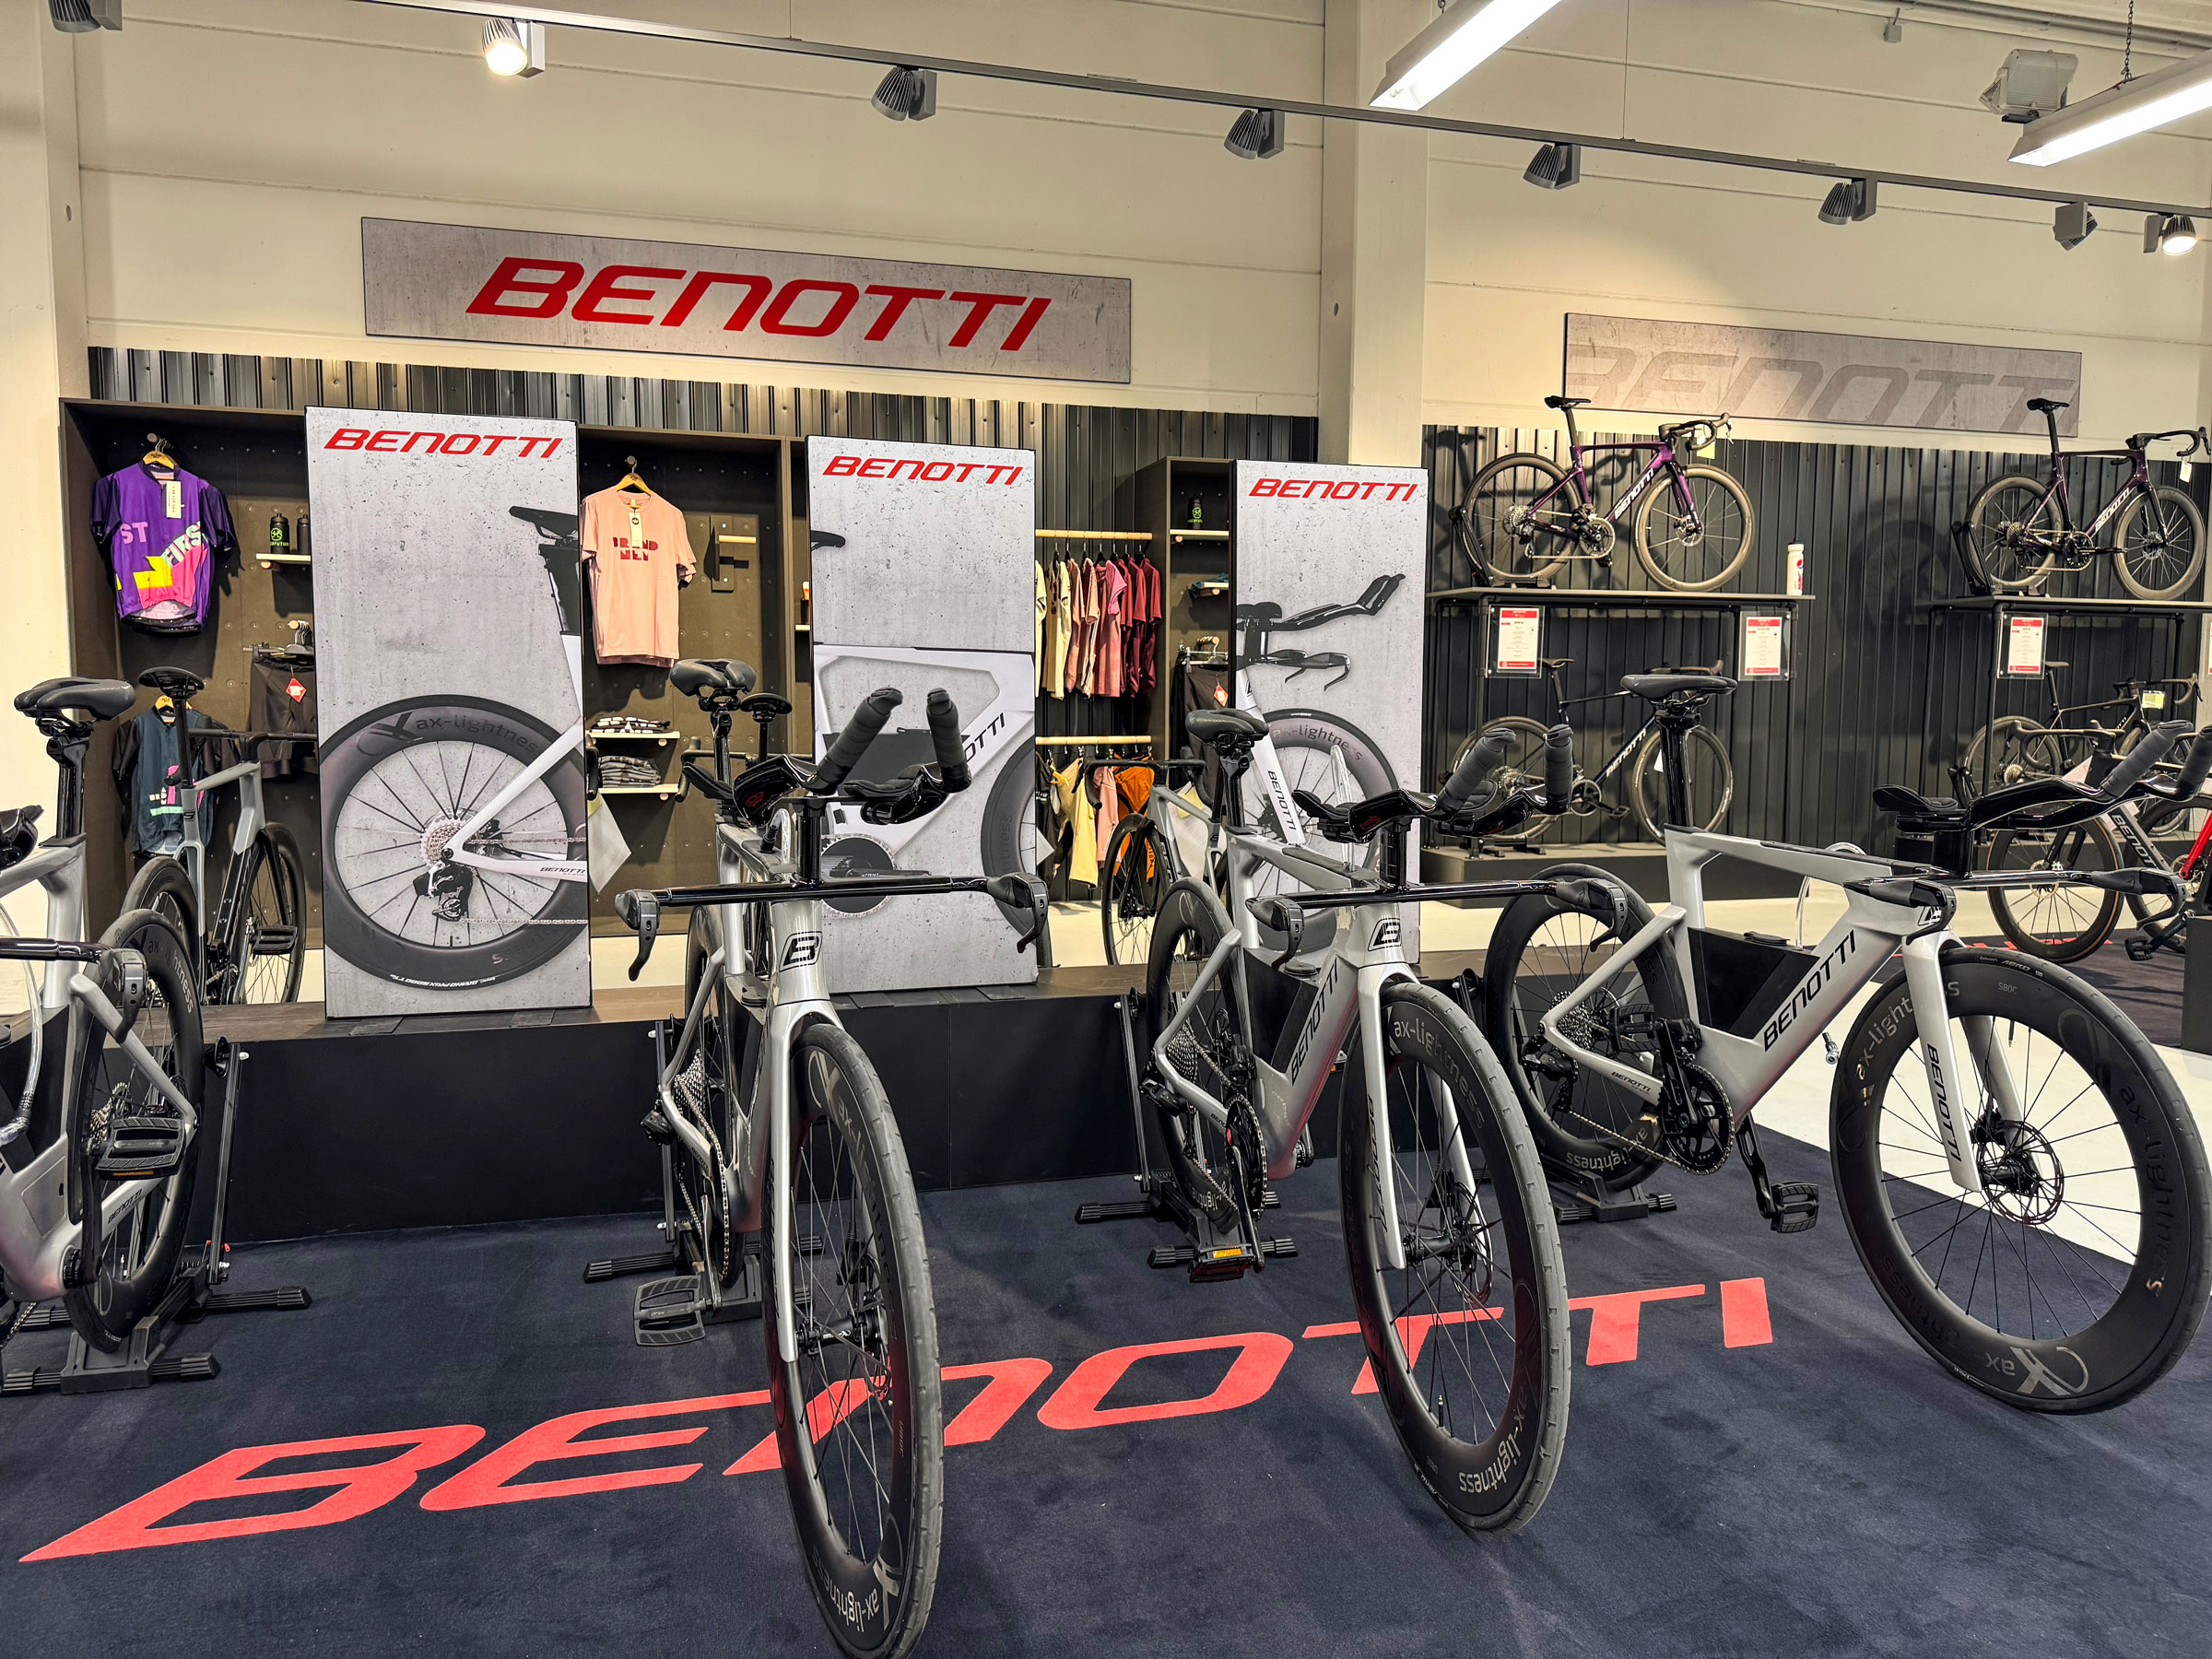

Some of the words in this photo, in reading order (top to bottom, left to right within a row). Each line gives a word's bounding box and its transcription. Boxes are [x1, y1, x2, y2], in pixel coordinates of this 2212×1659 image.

[465, 257, 1052, 352] BENOTTI
[324, 428, 563, 459] BENOTTI
[822, 455, 1024, 486] BENOTTI
[1248, 477, 1418, 502] BENOTTI
[1614, 467, 1654, 520] BENOTTI
[2093, 487, 2131, 534] BENOTTI
[612, 536, 658, 551] BRND
[415, 714, 541, 754] ax-lightnes
[965, 712, 1006, 762] OTTI
[1606, 727, 1647, 778] BENOTTI
[1267, 771, 1297, 830] BENOTTI
[2112, 814, 2158, 869] BENOT
[1764, 929, 1856, 1052] BENOTTI
[1292, 956, 1337, 1087] BENOTTI
[1855, 981, 1960, 1081] ax-lights
[1394, 1018, 1486, 1129] ax-lightness
[1611, 1070, 1652, 1092] BENOTTI
[1210, 1112, 1227, 1127] BENO
[1927, 1042, 1962, 1162] BENOTTI
[107, 1188, 143, 1224] BENOTTI
[19, 1277, 1774, 1564] BENOTTI
